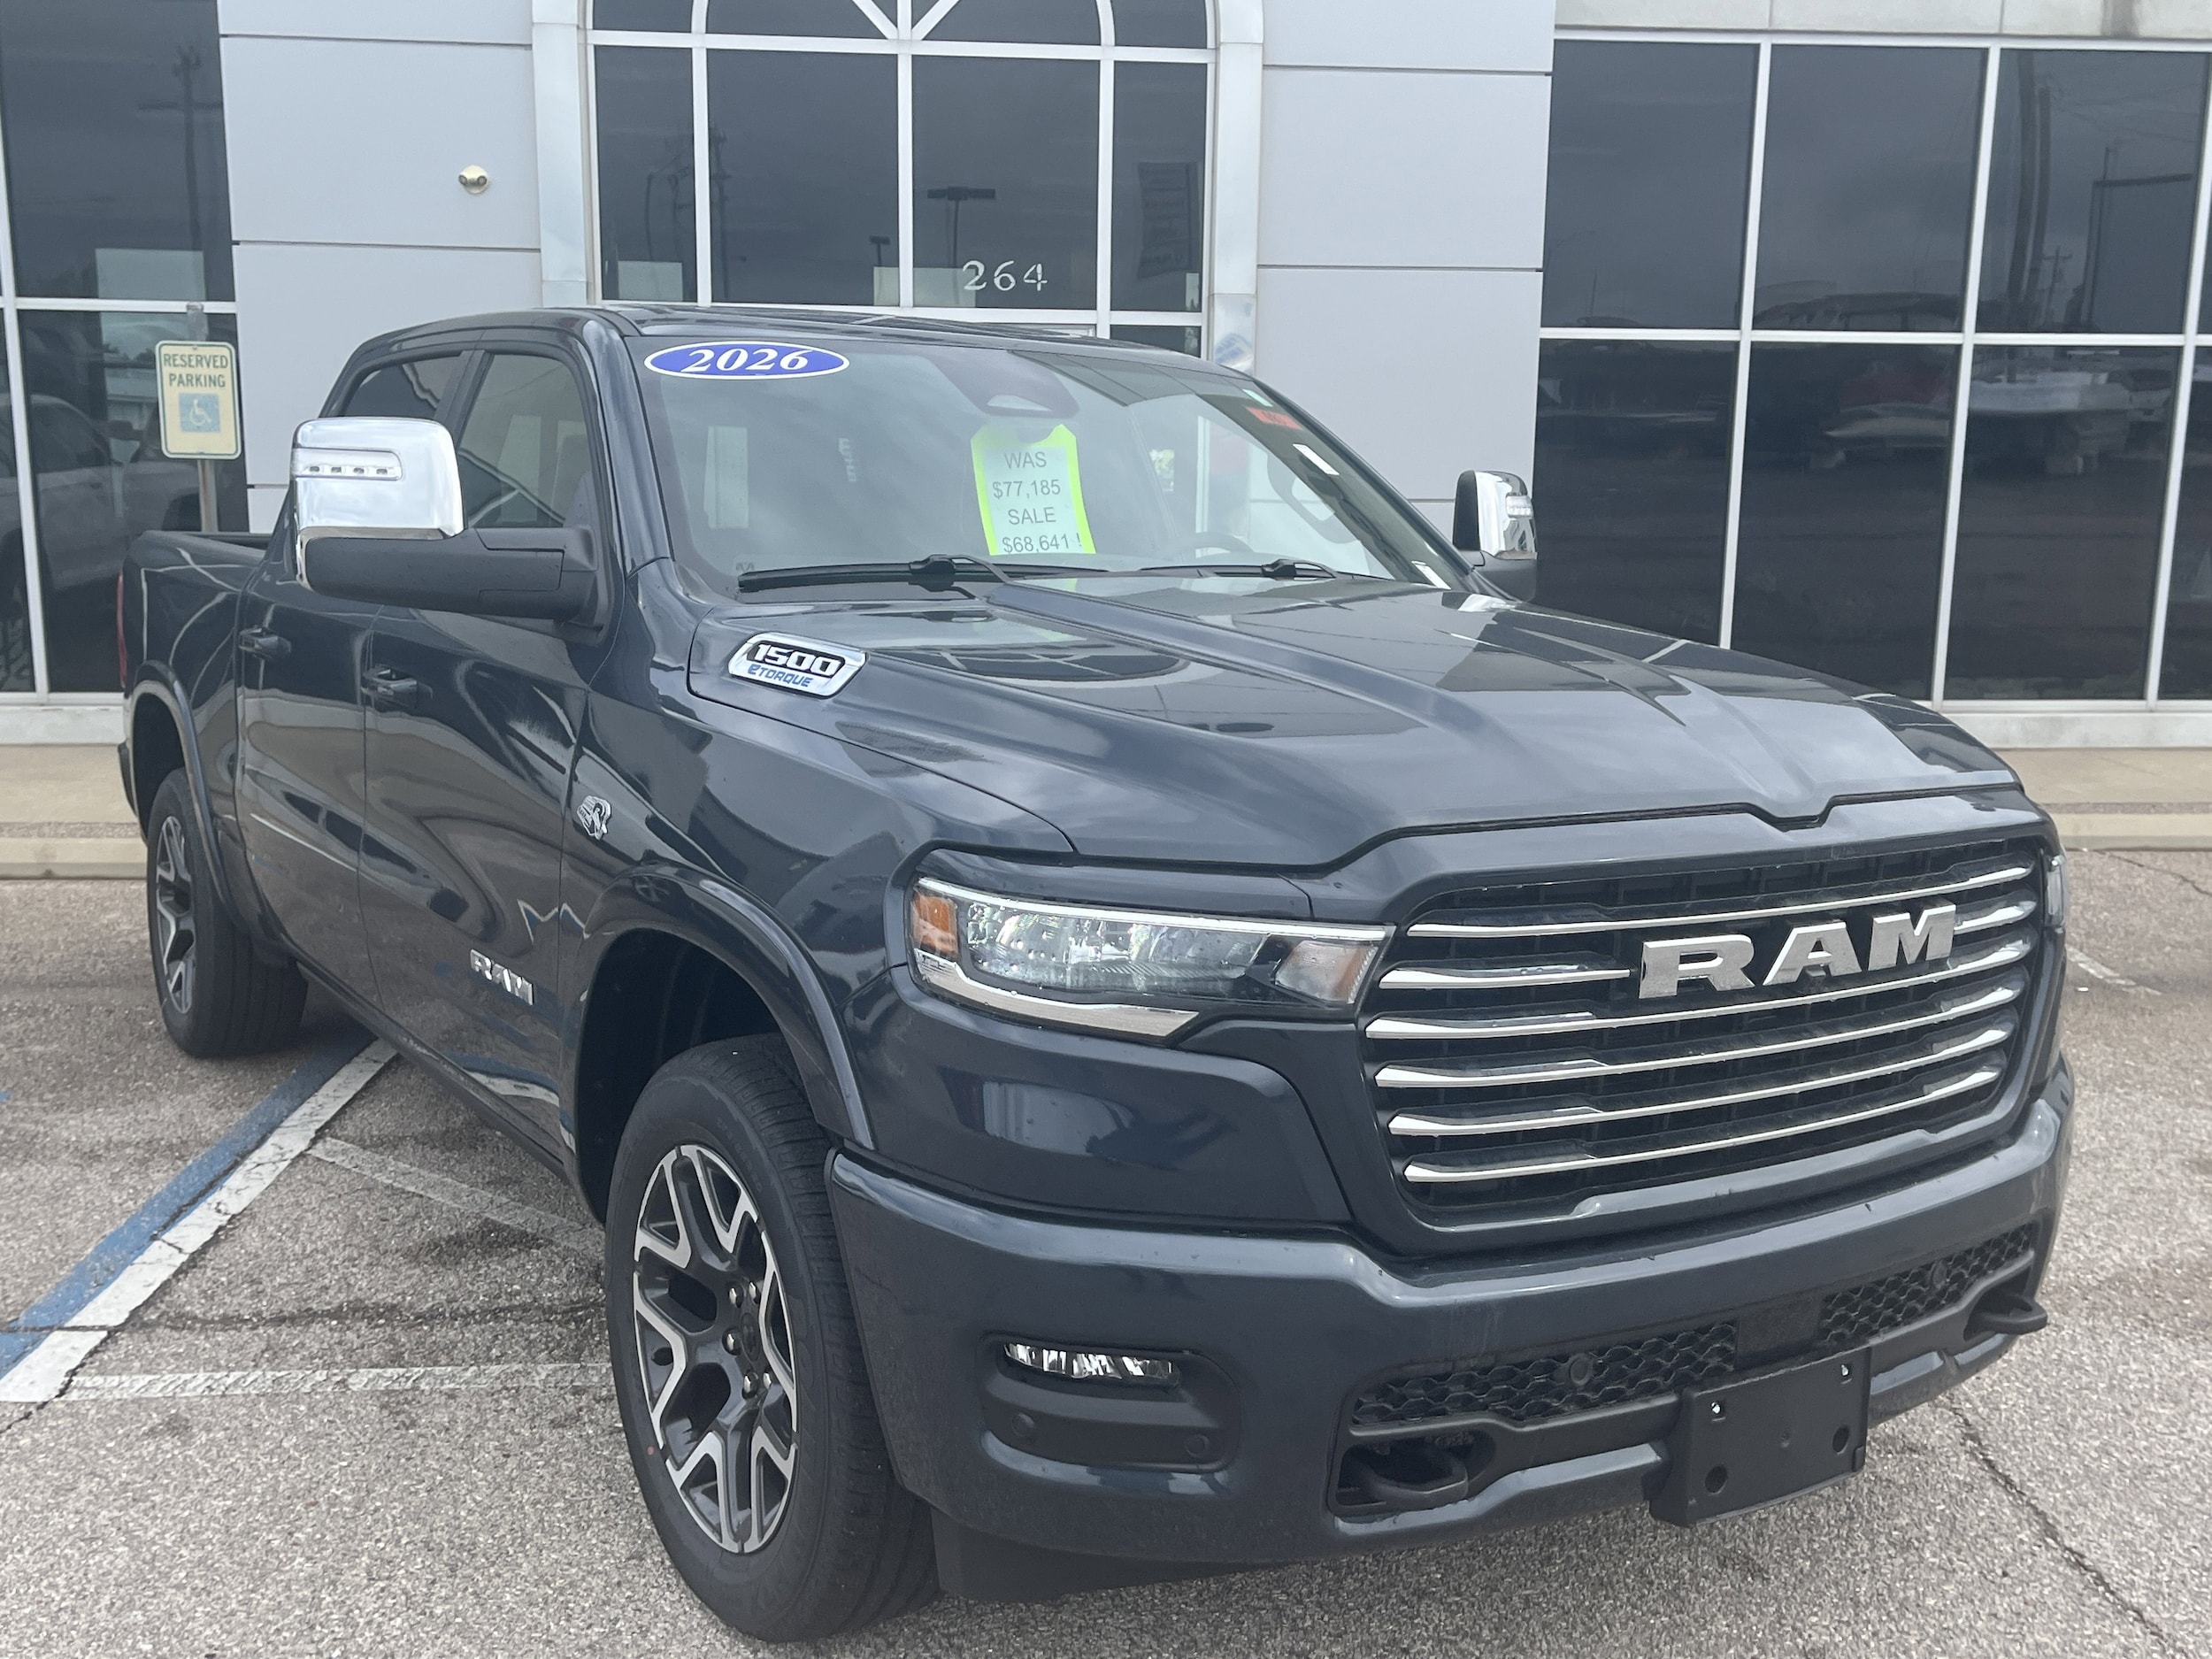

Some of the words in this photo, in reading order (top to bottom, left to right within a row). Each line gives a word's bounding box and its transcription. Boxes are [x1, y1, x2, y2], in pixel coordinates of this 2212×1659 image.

[962, 259, 1048, 292] 264
[163, 353, 228, 369] RESERVED
[680, 347, 814, 373] 2026
[168, 373, 227, 388] PARKING
[1003, 450, 1048, 470] WAS
[992, 479, 1061, 500] $77,185
[1007, 506, 1057, 526] SALE
[753, 642, 841, 677] 1500
[1638, 903, 1957, 1000] RAM
[469, 948, 534, 1006] RAM
